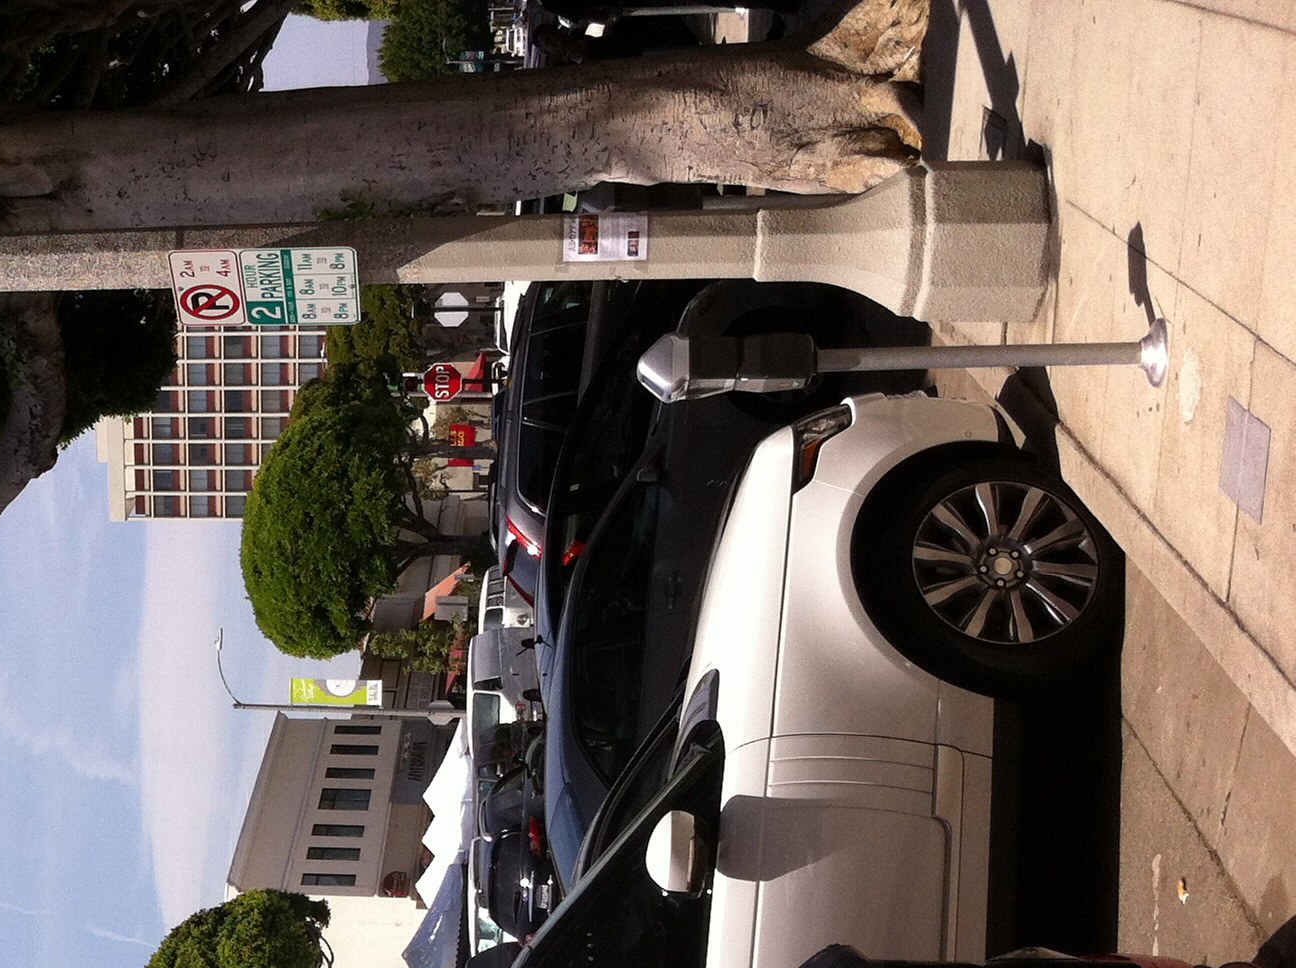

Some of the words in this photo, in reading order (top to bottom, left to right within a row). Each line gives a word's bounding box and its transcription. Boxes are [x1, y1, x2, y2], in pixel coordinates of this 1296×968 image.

[180, 260, 195, 278] 2AM
[216, 259, 231, 277] 4AM
[297, 253, 312, 270] 11AM
[329, 253, 345, 270] 8PM
[244, 265, 258, 288] HOUR
[256, 253, 283, 299] PARKING
[299, 278, 315, 295] 8AM
[331, 276, 347, 296] 10PM
[251, 306, 281, 319] 2
[302, 303, 317, 319] 8AM
[333, 303, 349, 319] 8PM
[435, 366, 450, 398] STOP
